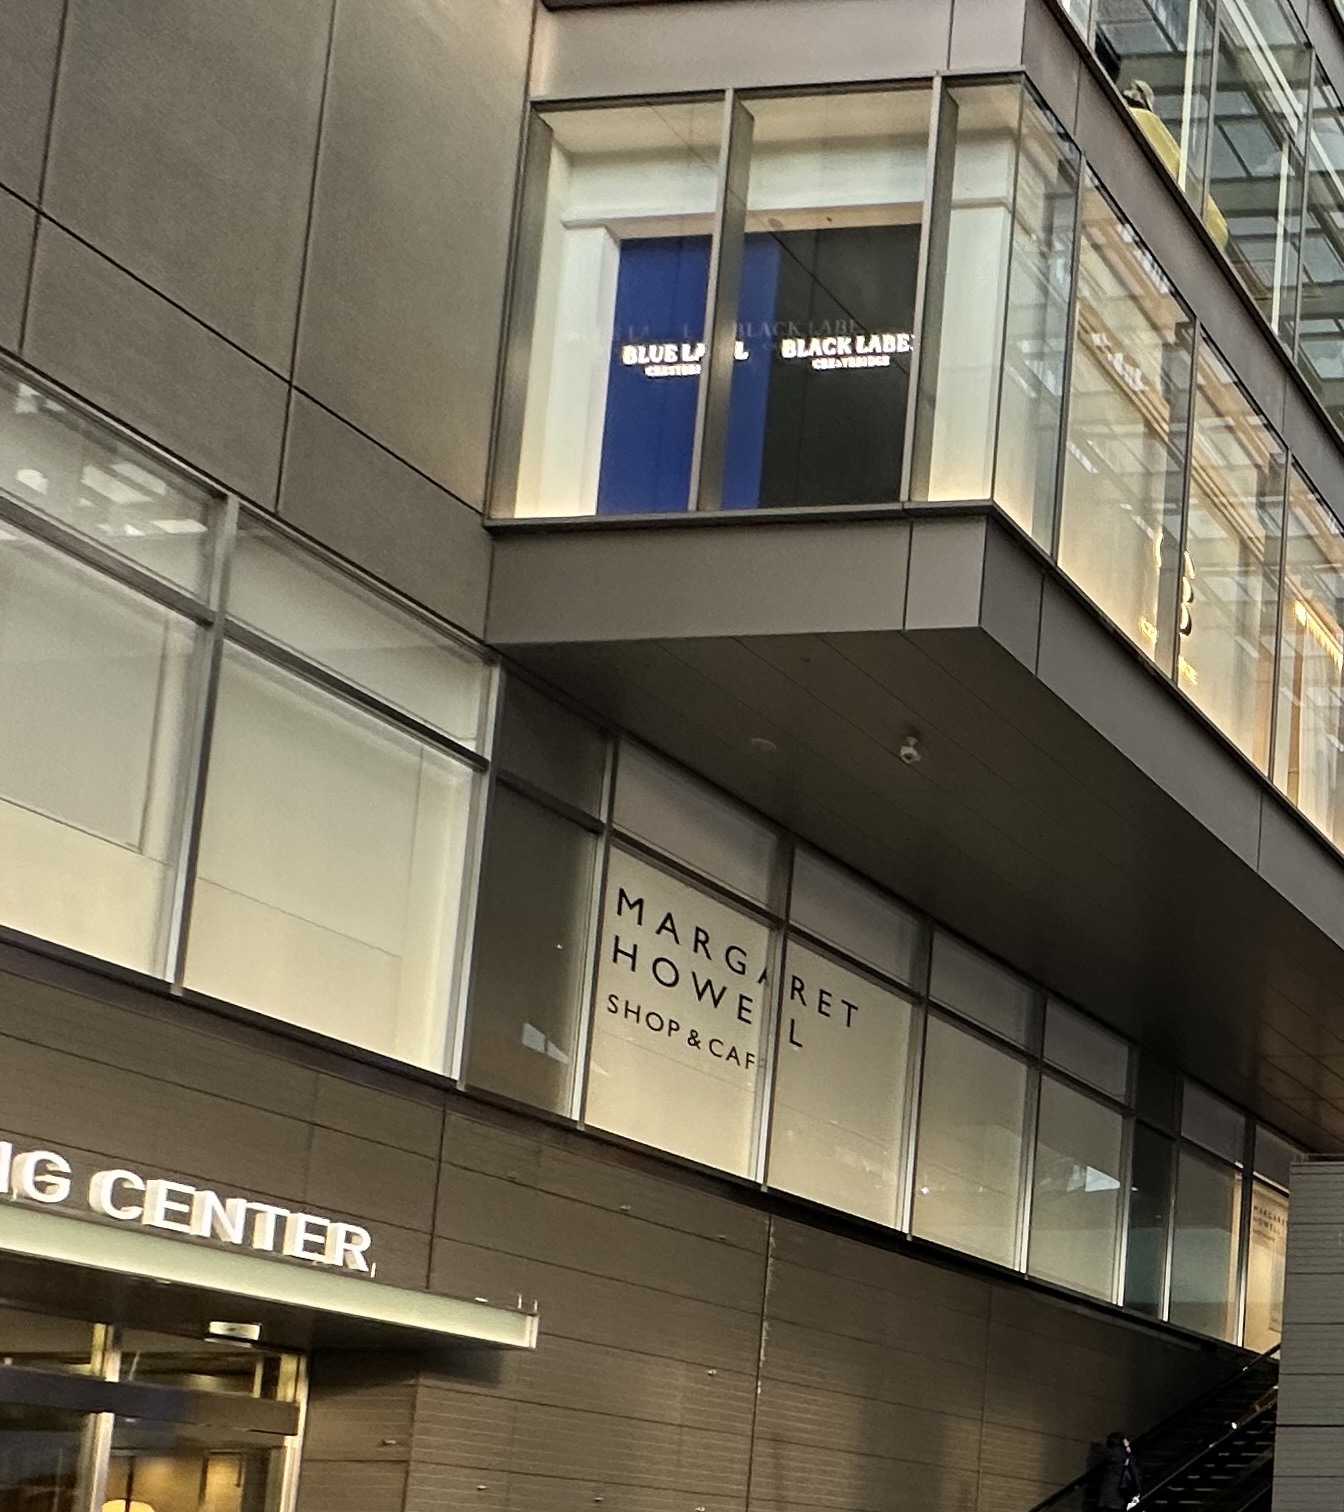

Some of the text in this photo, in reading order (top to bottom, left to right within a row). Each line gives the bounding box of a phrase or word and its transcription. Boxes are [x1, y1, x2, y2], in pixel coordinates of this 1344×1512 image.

[622, 343, 678, 365] BLUE
[781, 333, 915, 358] BLACK LABE
[612, 935, 803, 1048] HOWEL
[607, 994, 757, 1070] SHOP & CAF
[89, 1169, 373, 1273] CENTER
